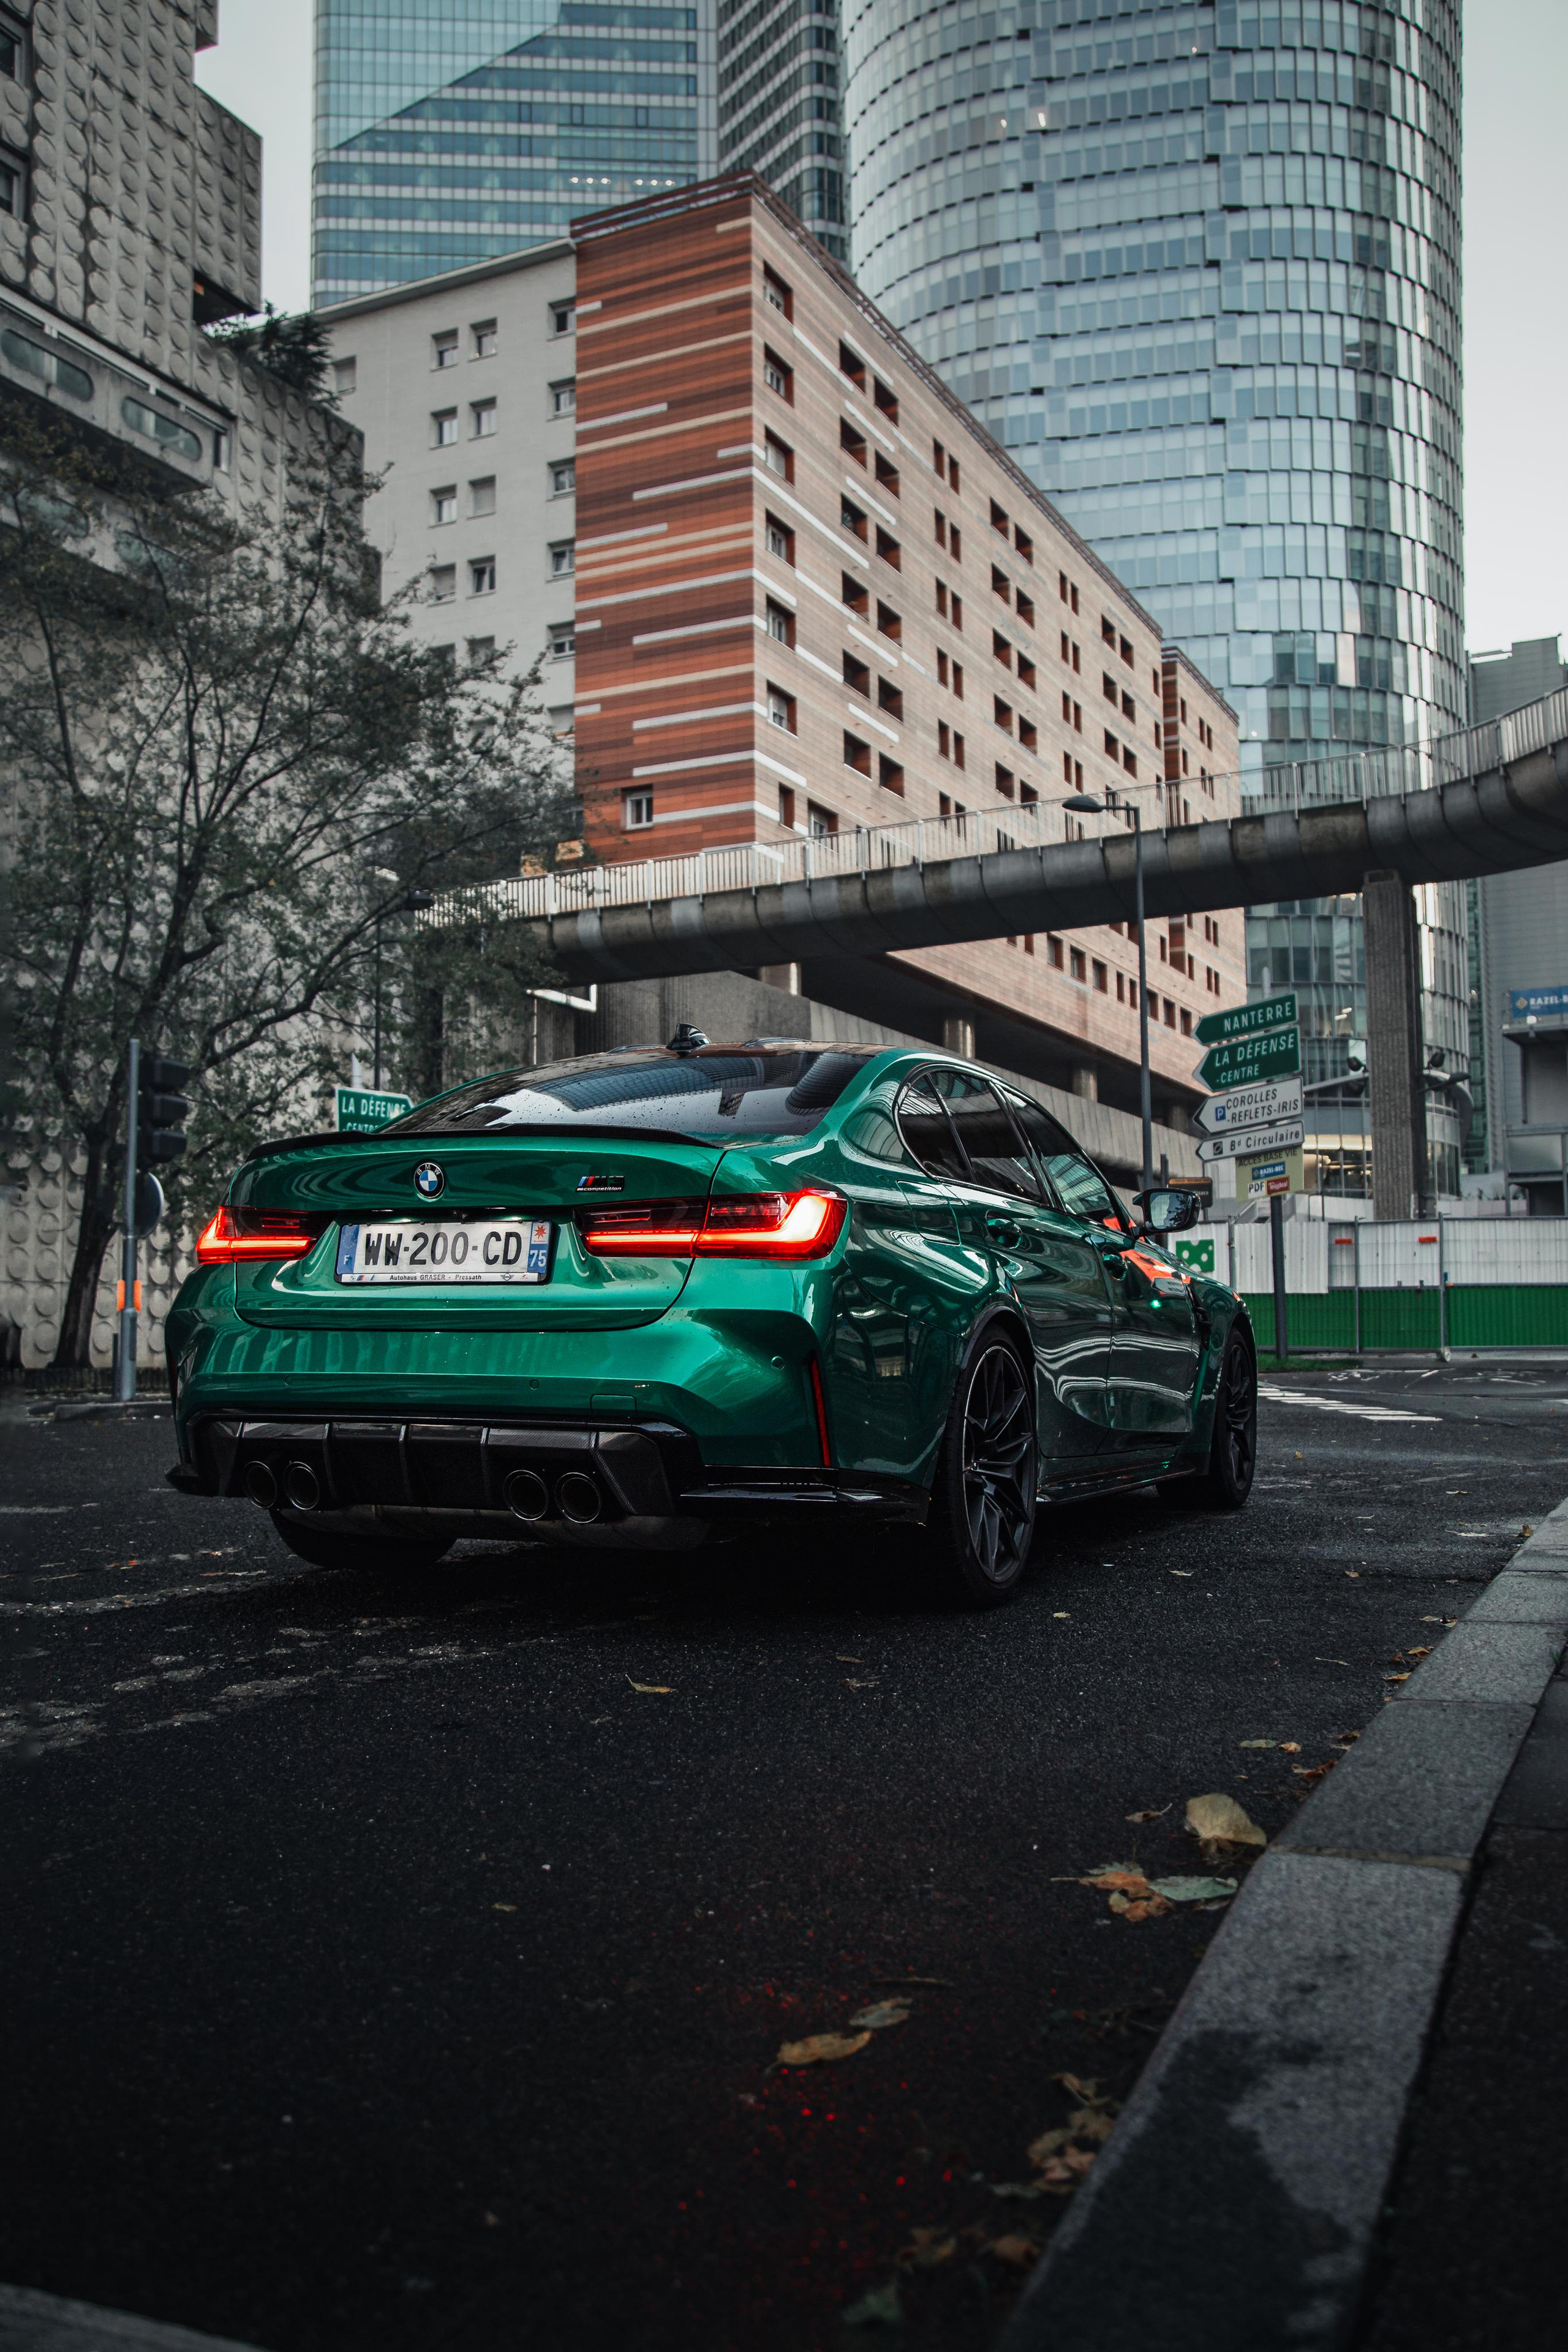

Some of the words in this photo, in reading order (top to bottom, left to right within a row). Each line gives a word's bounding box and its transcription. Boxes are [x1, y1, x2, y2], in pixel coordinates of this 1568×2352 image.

[1224, 1001, 1292, 1032] NANTERRE
[1215, 1050, 1229, 1066] LA
[1237, 1033, 1295, 1061] DÉFENSE
[342, 1096, 355, 1113] LA
[1226, 1088, 1277, 1109] COROLLES
[1231, 1139, 1241, 1152] Bd
[1246, 1129, 1300, 1148] Circulaire
[1264, 1151, 1283, 1162] BASE
[1285, 1148, 1297, 1157] VIE
[417, 1164, 440, 1175] BMW
[1249, 1182, 1264, 1193] PDF
[364, 1231, 522, 1266] WW-200-CD
[344, 1255, 350, 1265] F
[530, 1250, 547, 1267] 75
